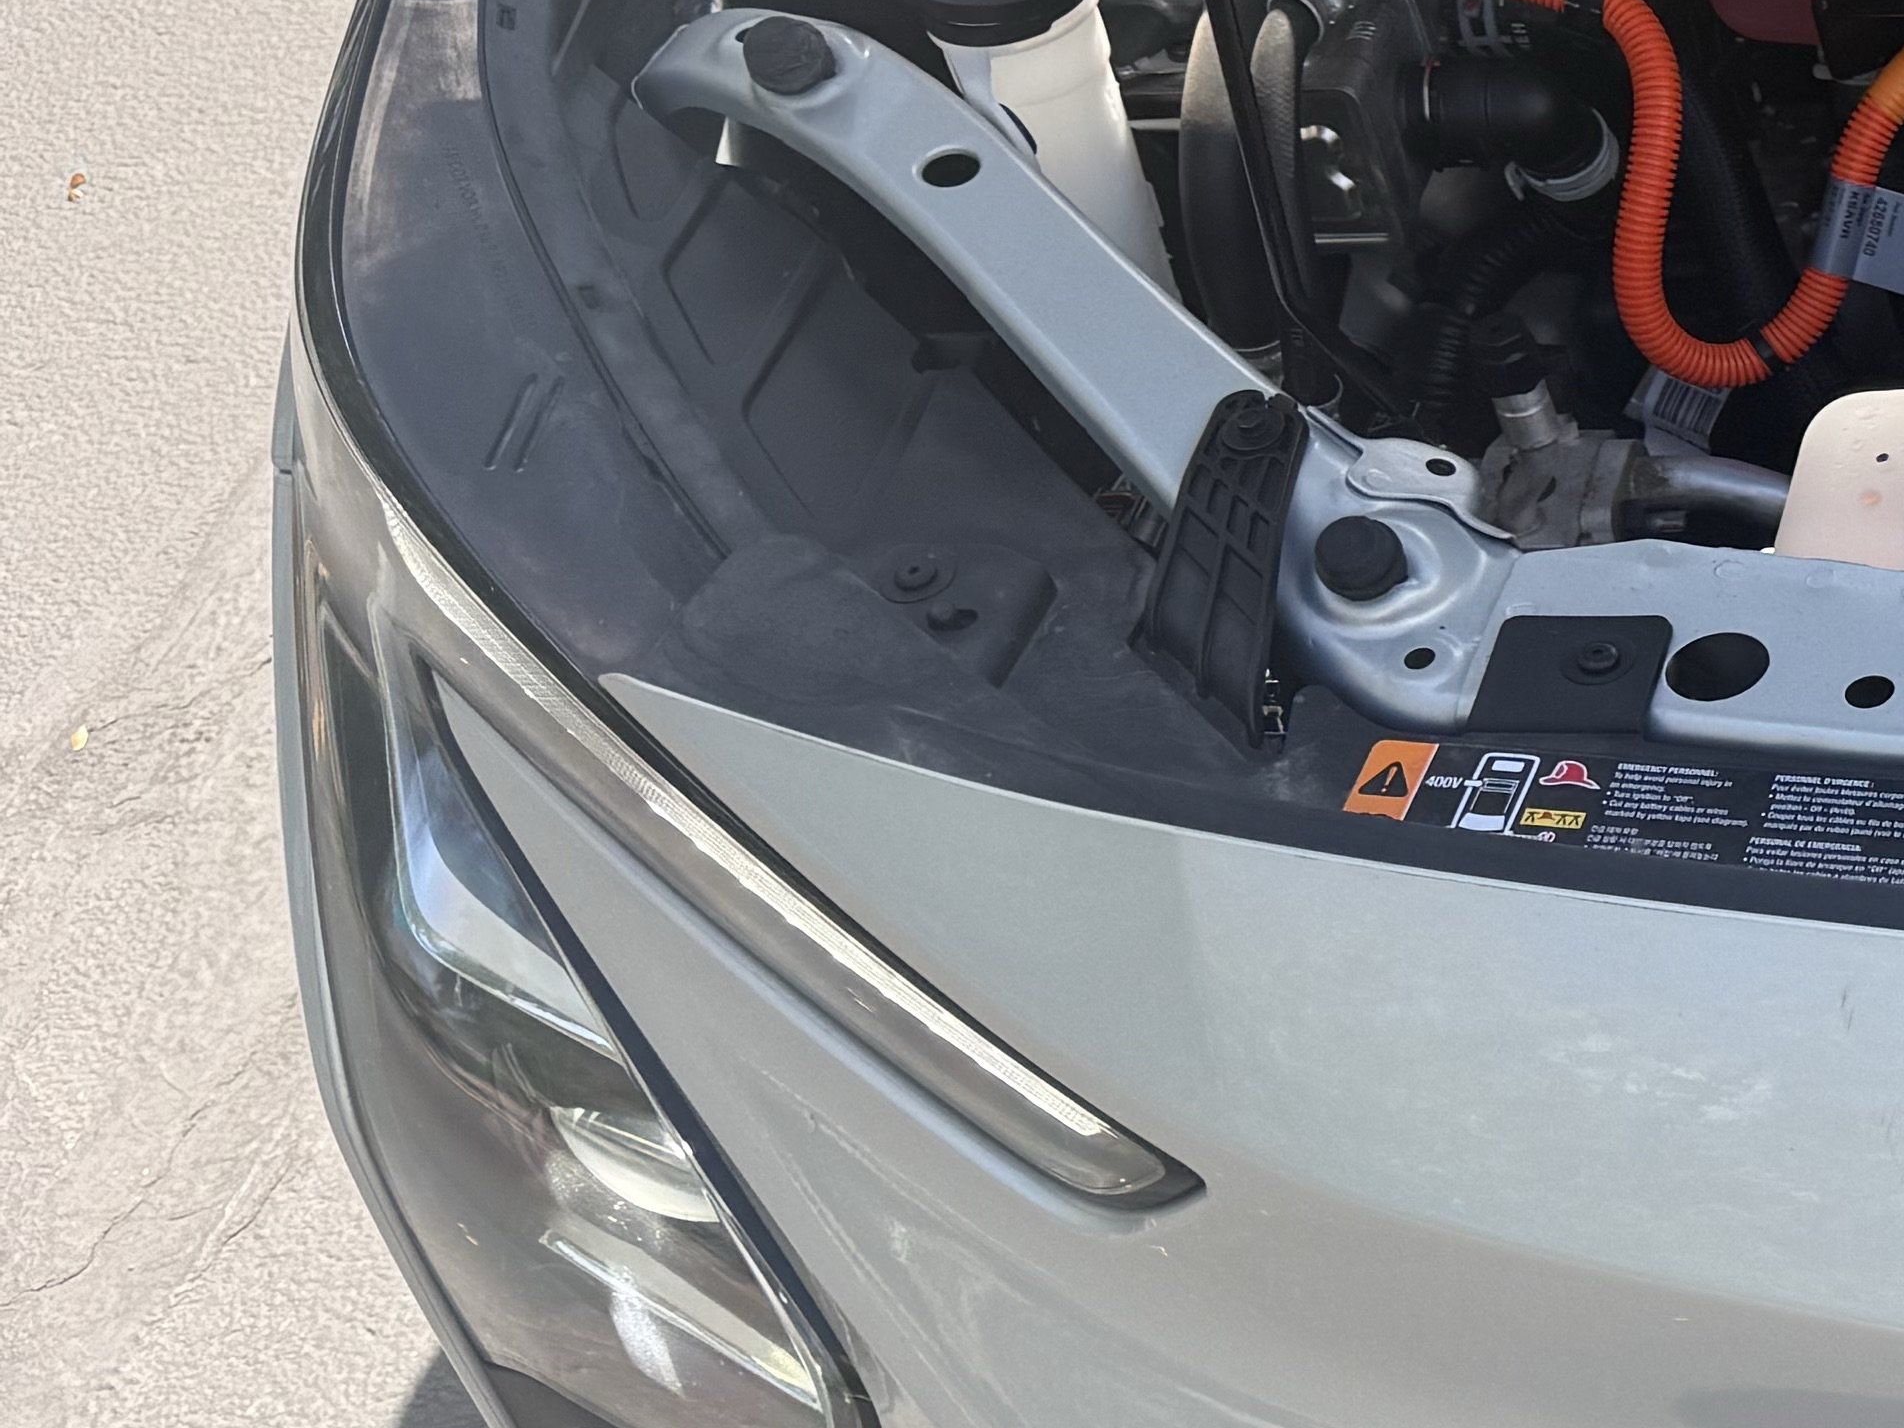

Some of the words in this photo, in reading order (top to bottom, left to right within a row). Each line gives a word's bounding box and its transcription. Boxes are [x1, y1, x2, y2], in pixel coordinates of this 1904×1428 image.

[1618, 762, 1666, 774] EMERGENCY
[1425, 776, 1464, 790] 400V
[1624, 772, 1643, 780] help
[1644, 774, 1665, 782] avoid
[1667, 776, 1700, 785] personal
[1700, 779, 1722, 787] injury
[1776, 774, 1821, 785] PERSONNEL
[1640, 802, 1667, 811] battery
[1669, 805, 1694, 813] cables
